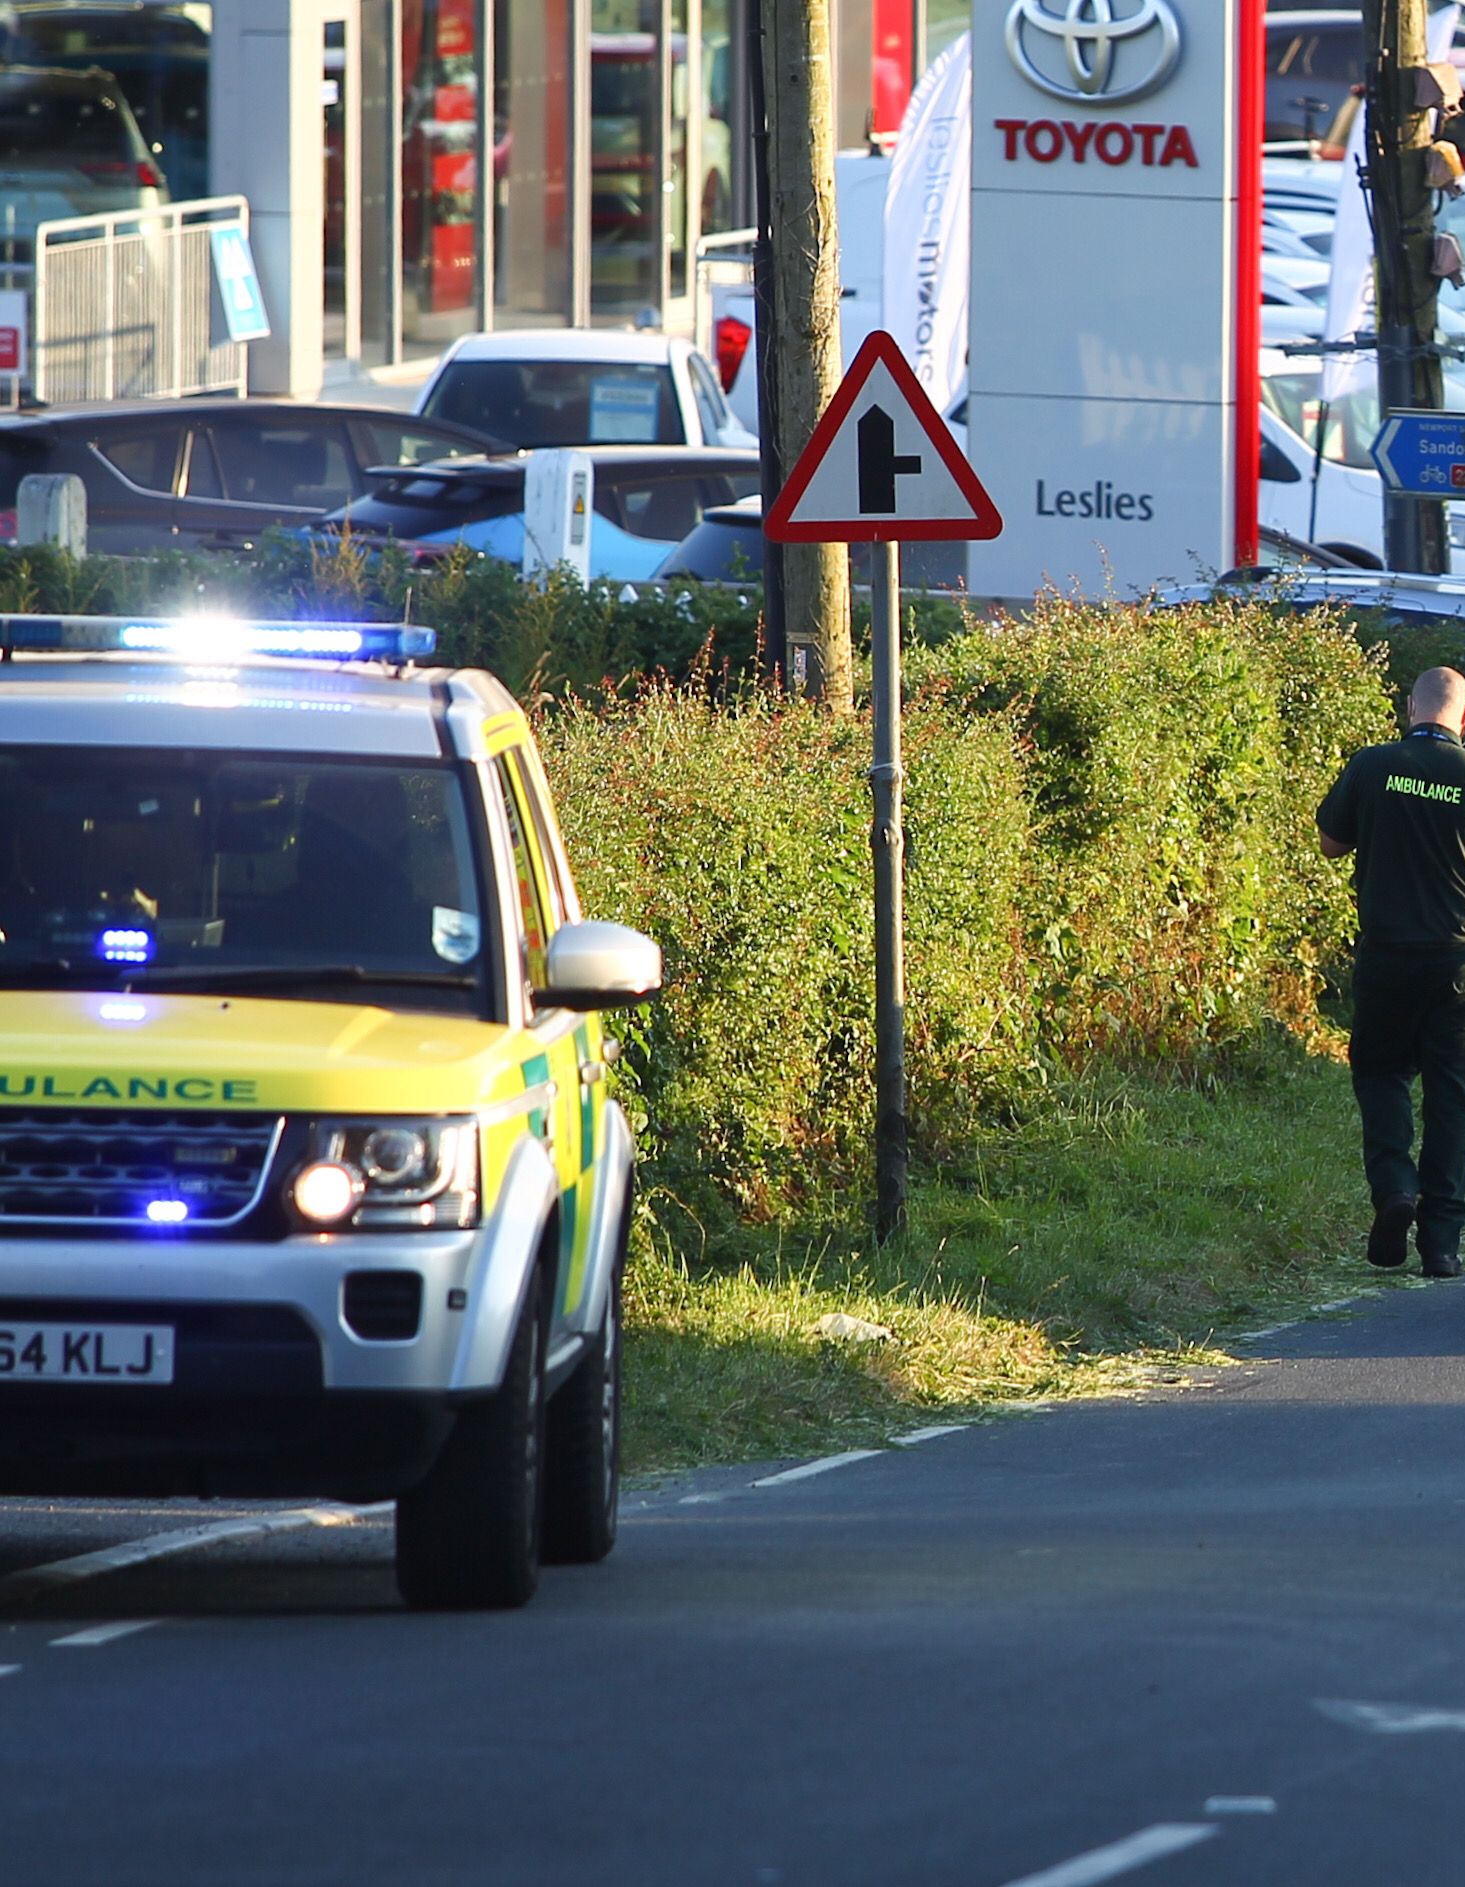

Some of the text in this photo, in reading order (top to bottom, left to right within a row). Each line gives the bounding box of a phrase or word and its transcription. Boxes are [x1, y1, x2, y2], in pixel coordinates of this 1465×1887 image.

[994, 119, 1199, 167] TOYOTA
[1418, 423, 1457, 433] NEWPORT
[1036, 479, 1154, 521] Leslies
[1385, 774, 1462, 804] AMBULANCE
[0, 1075, 258, 1102] ULANCE
[62, 1331, 154, 1375] KLJ
